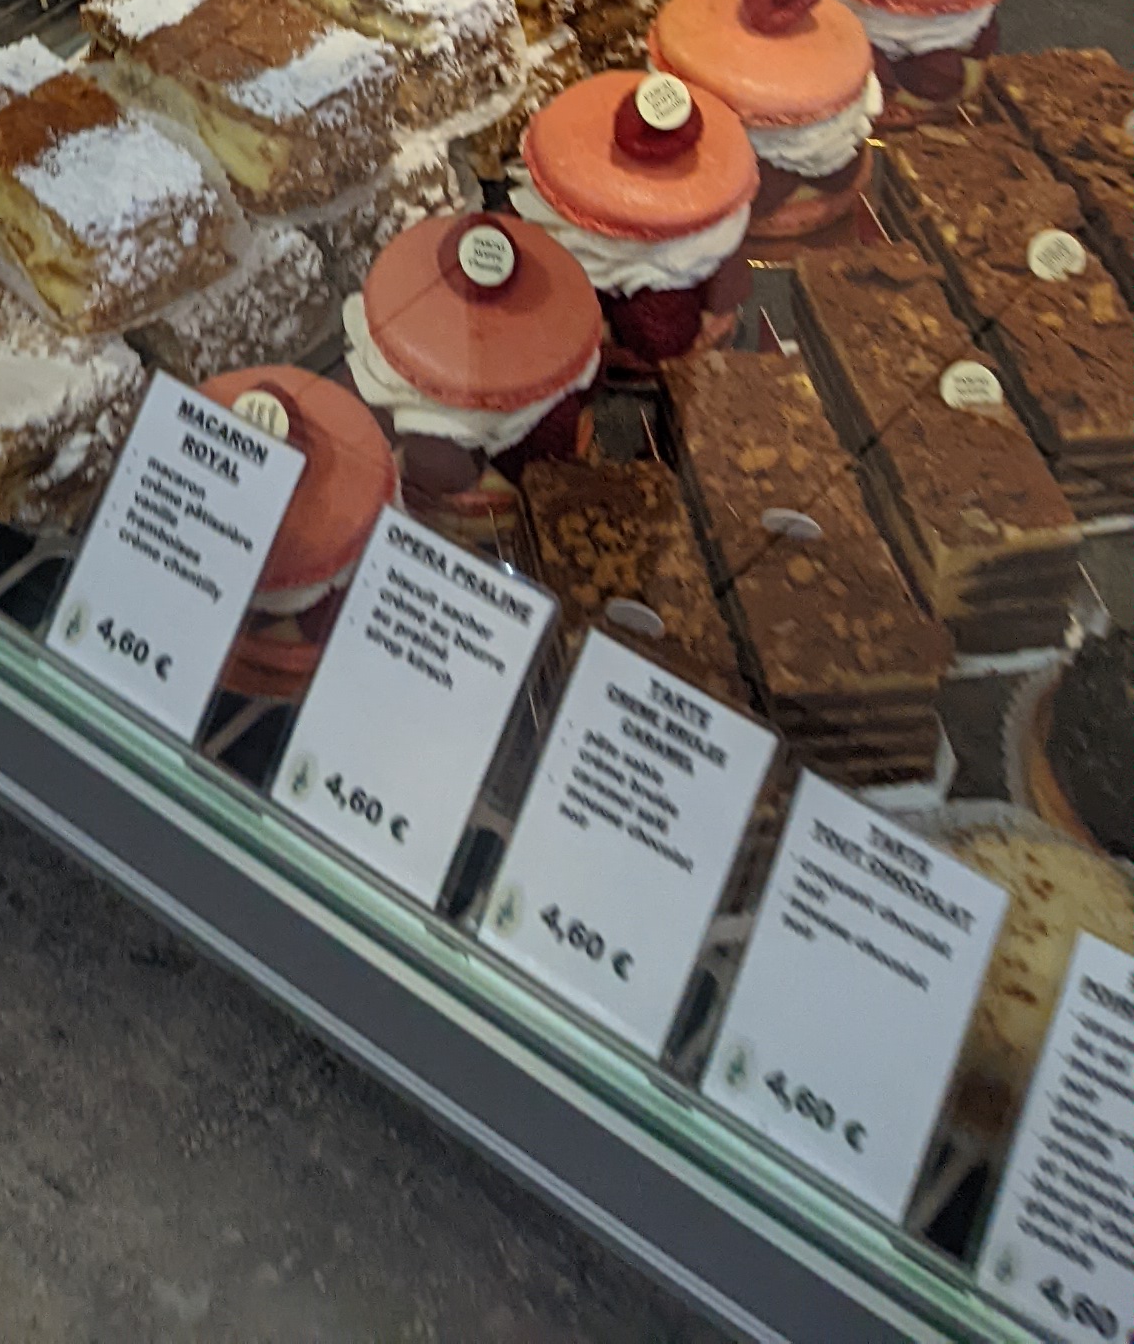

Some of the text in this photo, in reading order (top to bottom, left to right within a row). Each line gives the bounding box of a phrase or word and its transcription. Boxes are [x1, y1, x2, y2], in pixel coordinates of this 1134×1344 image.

[175, 397, 269, 467] MACARON
[179, 432, 244, 485] ROYAL
[131, 488, 180, 529] vanille
[137, 471, 184, 510] crème
[145, 454, 208, 503] macaron
[116, 524, 224, 606] crème chantilly
[383, 522, 536, 626] OPERA PRALINE
[370, 605, 393, 628] au
[376, 584, 509, 676] crème au beurre
[384, 565, 496, 644] biscuit sacher
[92, 611, 175, 683] 4,60 €
[362, 622, 405, 659] sirop
[644, 677, 714, 731] TARTE
[617, 715, 699, 776] CARAMEL
[319, 768, 412, 845] 4,60 €
[534, 897, 637, 983] 4,60 €
[839, 1114, 871, 1157] €
